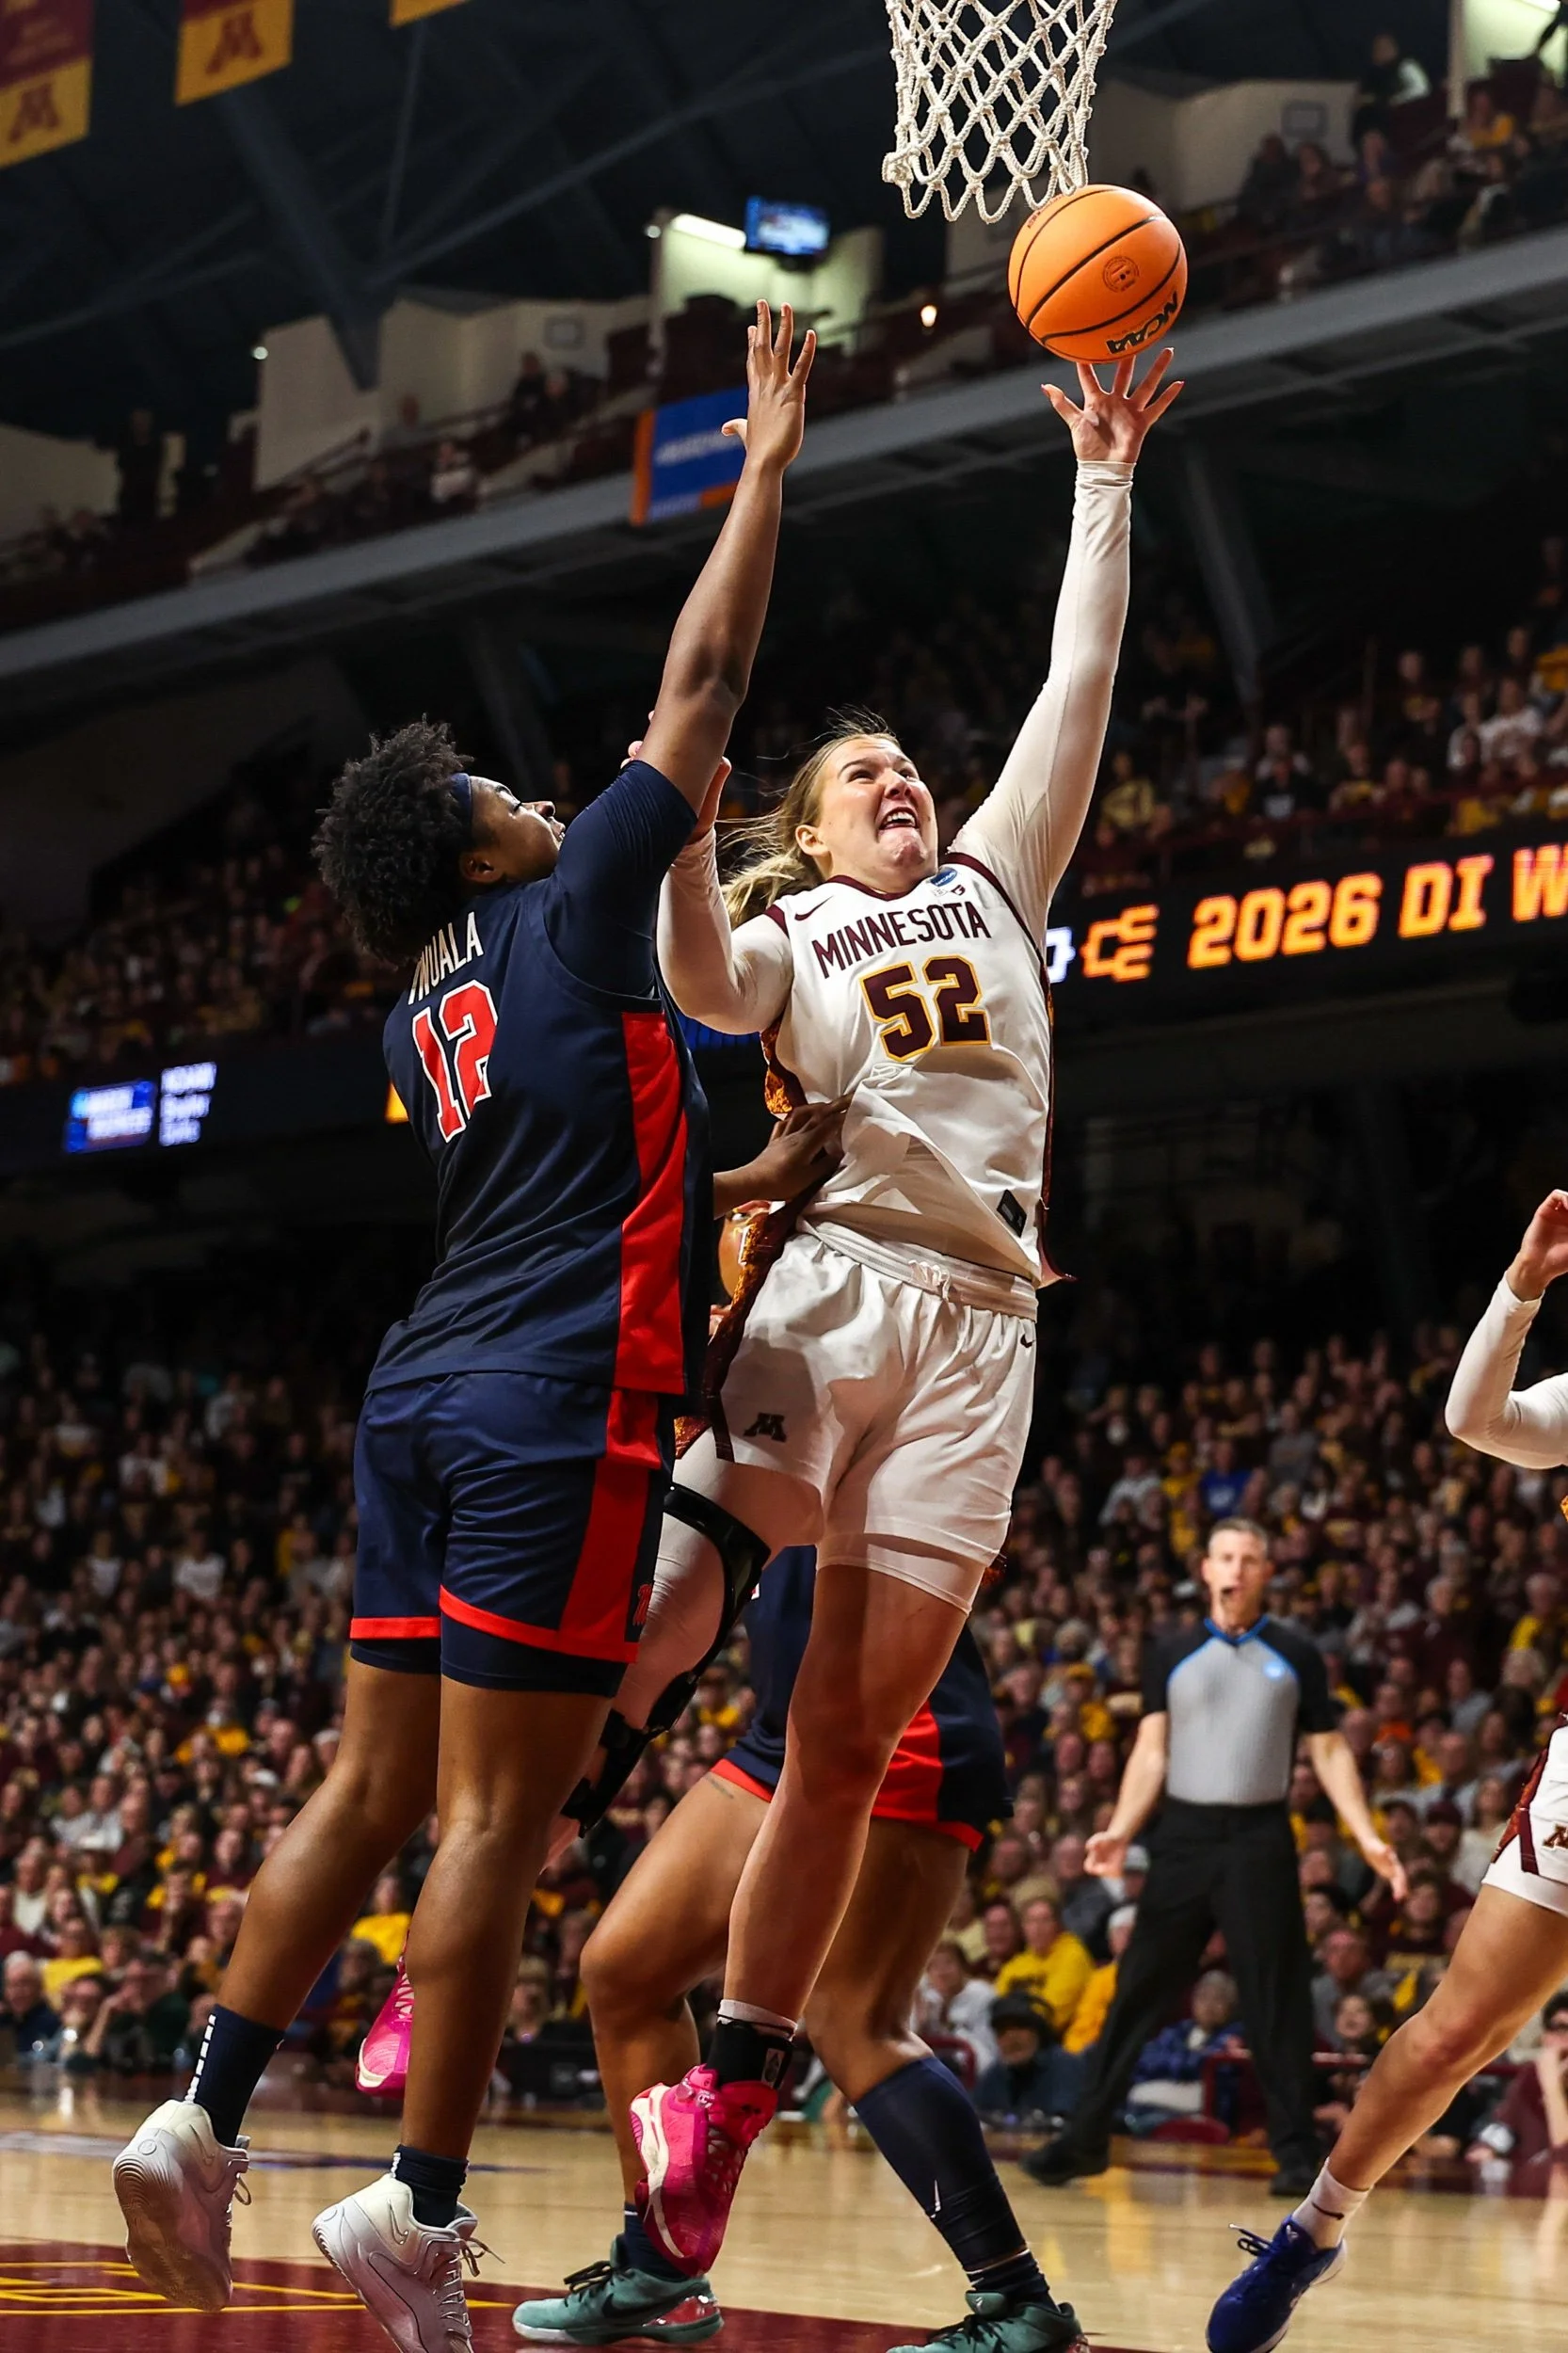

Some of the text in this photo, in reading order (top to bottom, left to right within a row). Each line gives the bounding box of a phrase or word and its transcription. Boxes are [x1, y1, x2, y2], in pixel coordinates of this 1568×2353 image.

[1106, 289, 1178, 354] NCAA
[810, 901, 992, 979] MINNESOTA
[1189, 872, 1383, 968] 2026
[1399, 853, 1495, 939] DI
[859, 954, 991, 1062] 52
[412, 979, 498, 1143] 12
[743, 1412, 787, 1443] M
